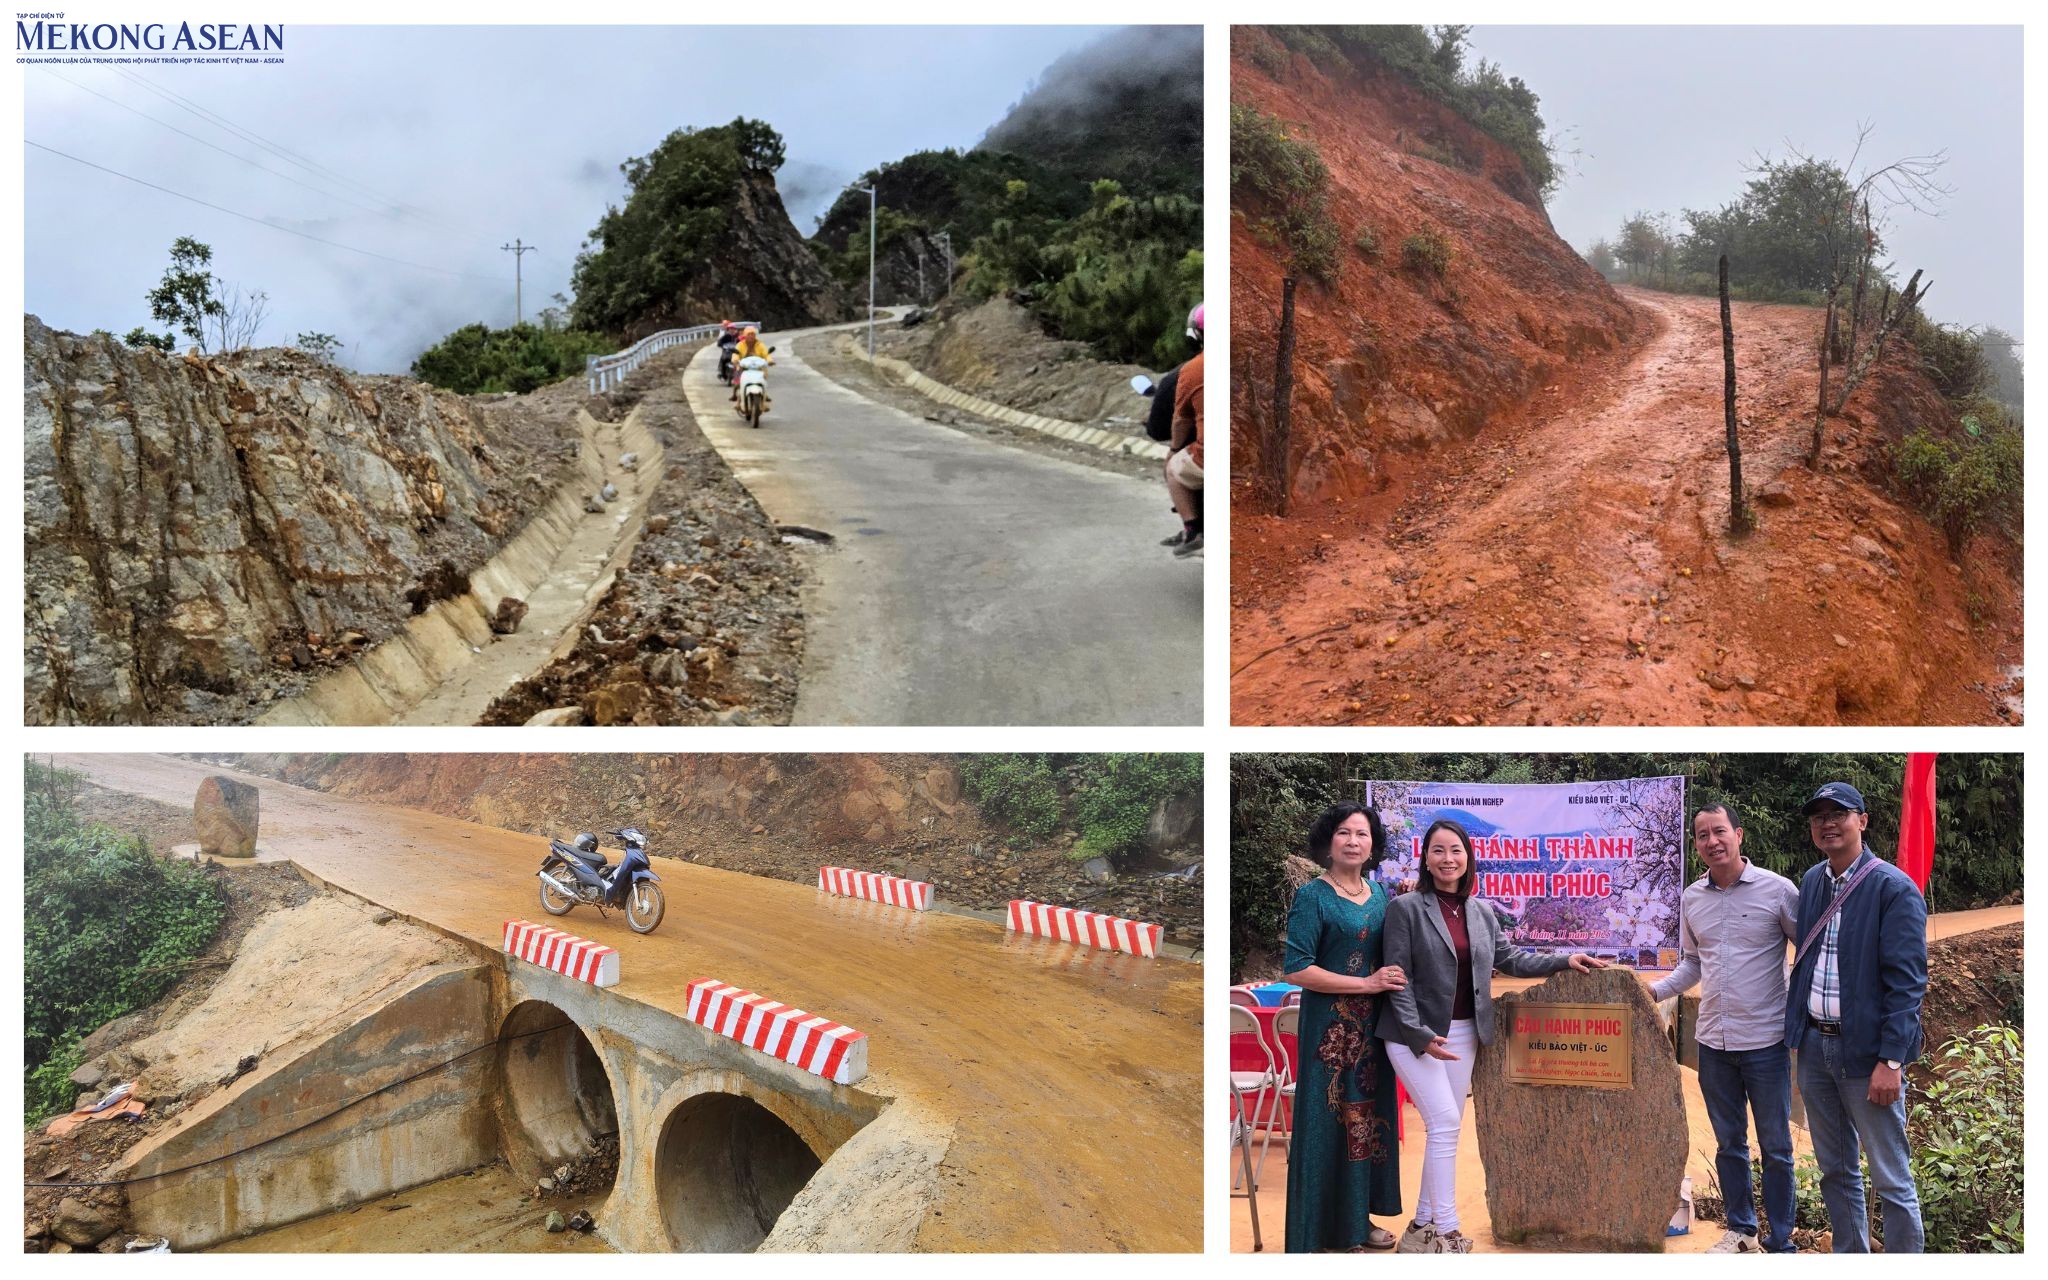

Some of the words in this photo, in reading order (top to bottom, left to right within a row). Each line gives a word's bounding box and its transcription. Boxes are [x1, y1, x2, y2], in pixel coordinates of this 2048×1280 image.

[1408, 796, 1421, 804] BAN
[1423, 795, 1440, 806] QUẢN
[1442, 796, 1450, 806] LÝ
[1600, 794, 1614, 805] VIỆT
[1470, 834, 1538, 859] HÁNH
[1546, 833, 1634, 859] THÀNH
[1485, 874, 1545, 901] HẠNH
[1552, 869, 1611, 897] PHÚC
[1529, 929, 1556, 942] tháng
[1568, 930, 1588, 940] năm
[1544, 1018, 1580, 1037] HẠNH
[1586, 1016, 1622, 1036] PHÚC
[1550, 1042, 1568, 1050] BÀO
[1570, 1042, 1587, 1053] VIỆT
[1594, 1043, 1608, 1052] ÚC
